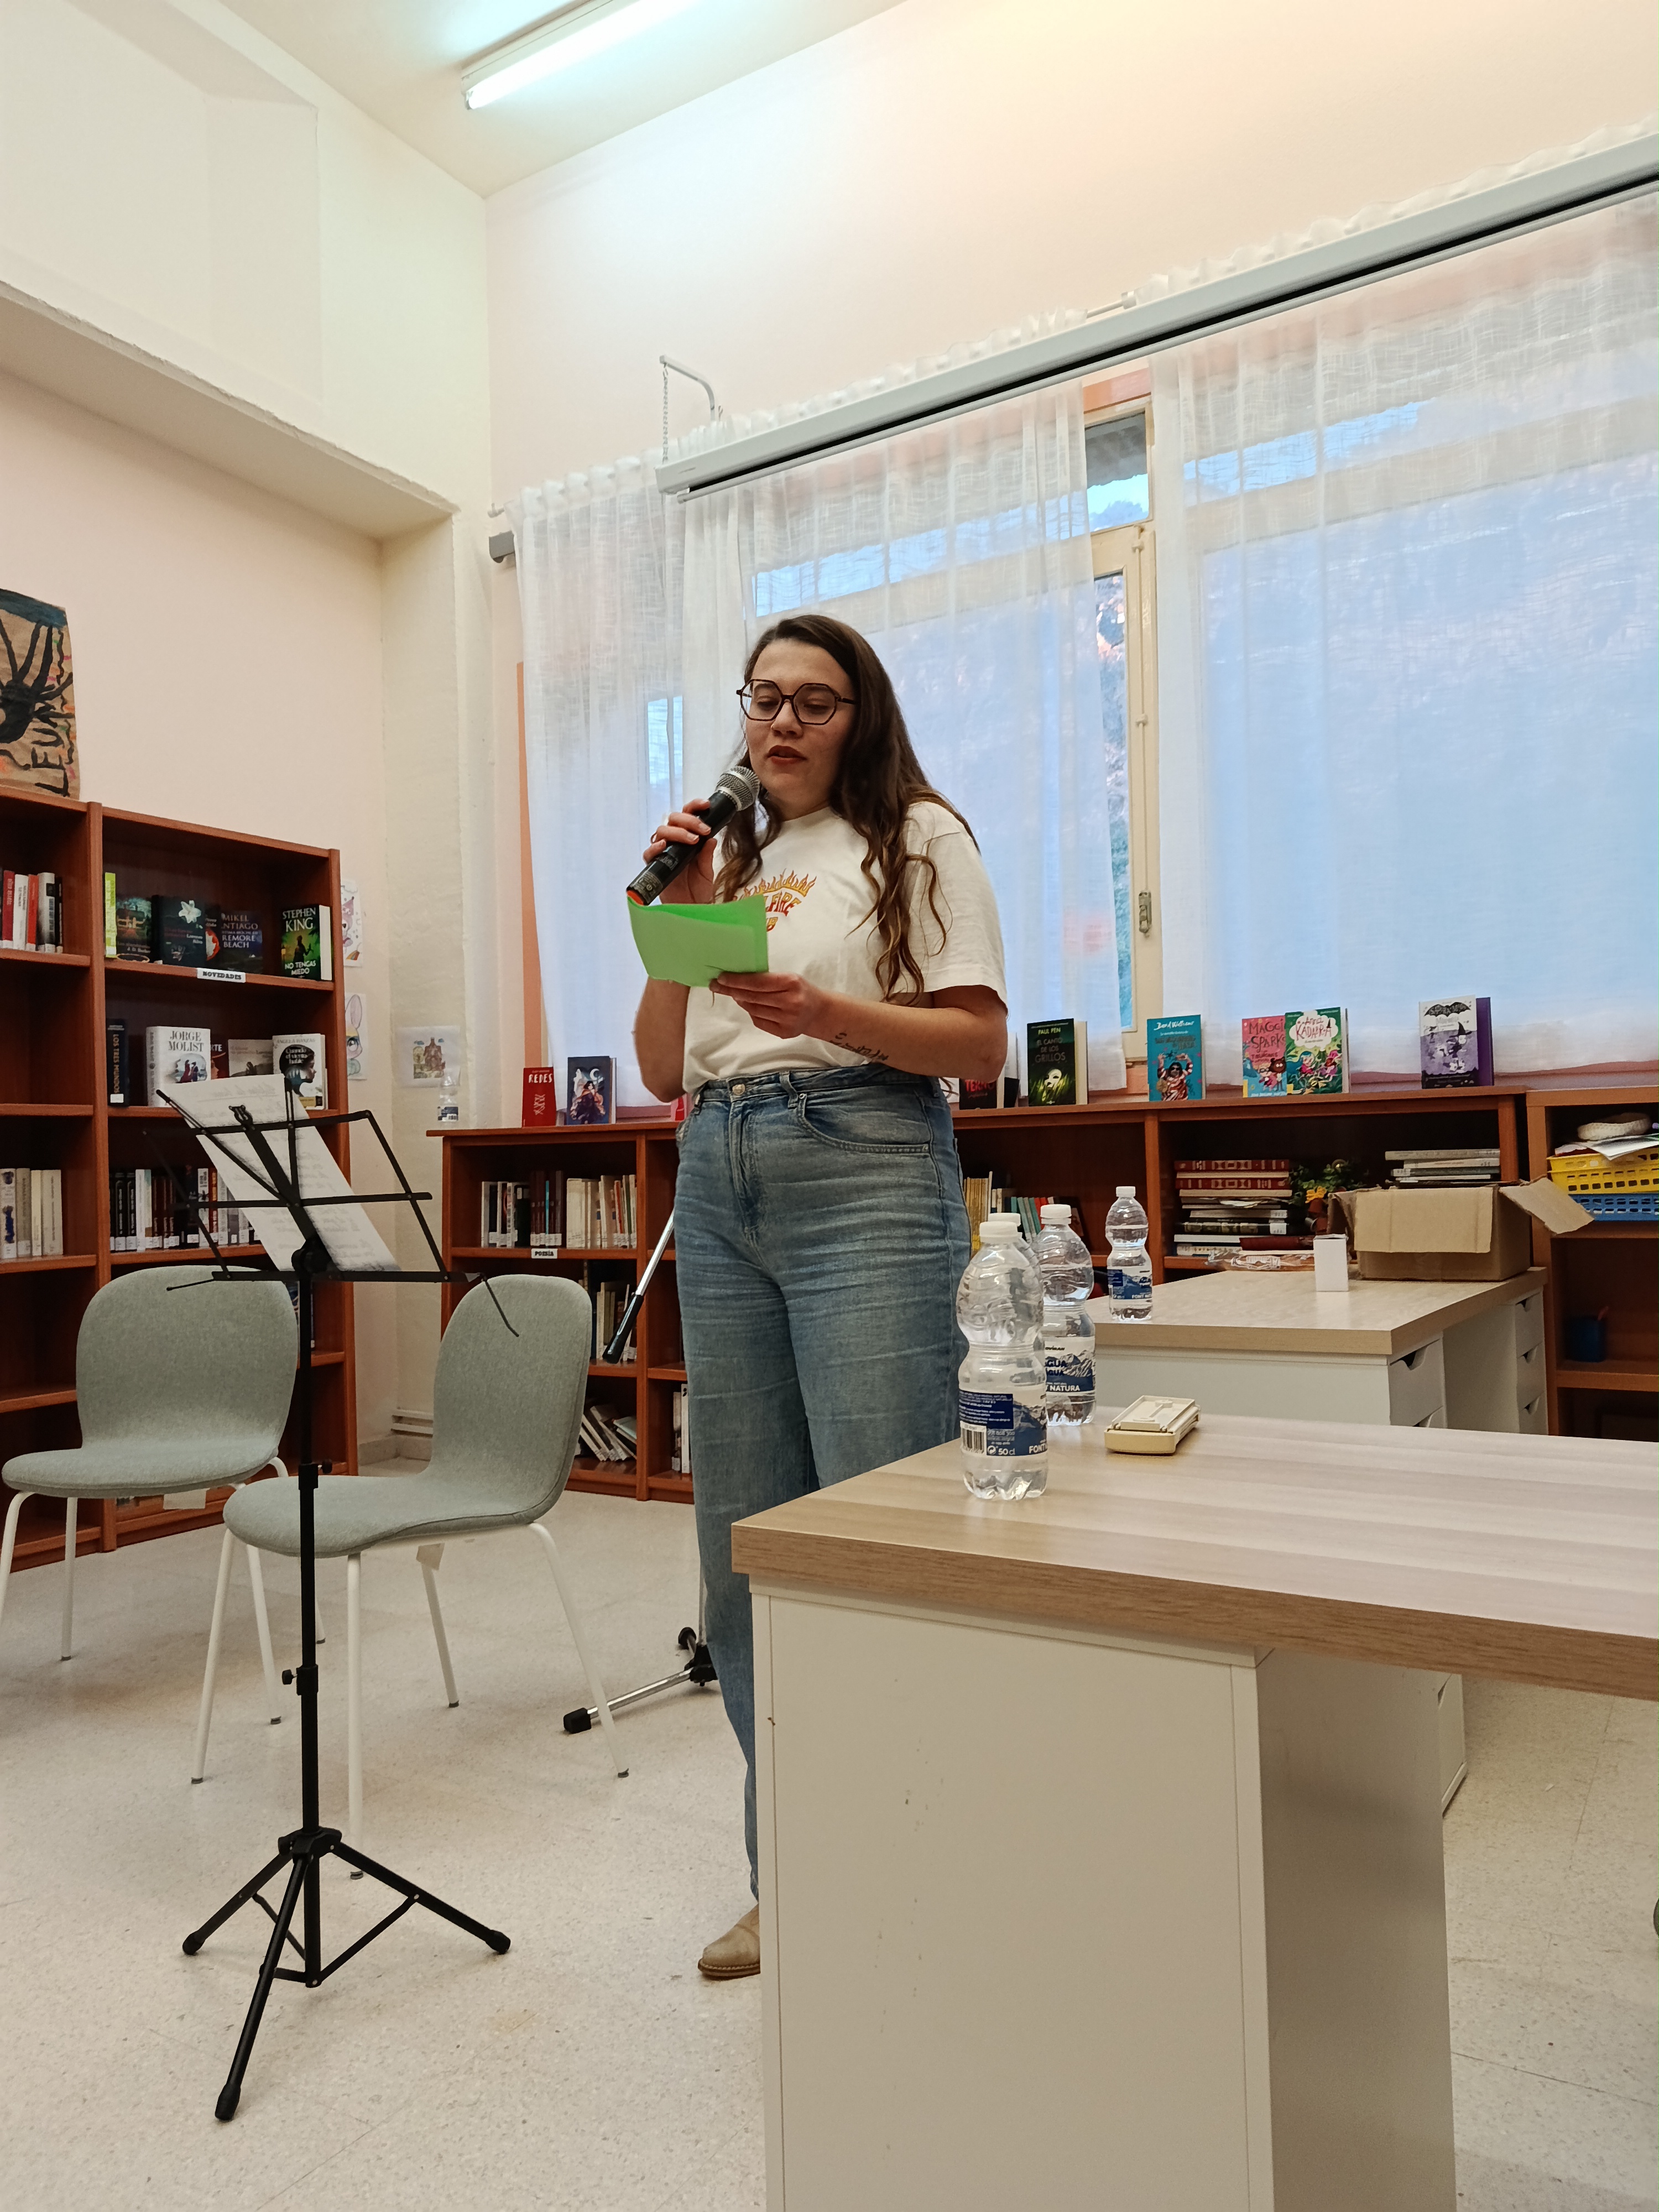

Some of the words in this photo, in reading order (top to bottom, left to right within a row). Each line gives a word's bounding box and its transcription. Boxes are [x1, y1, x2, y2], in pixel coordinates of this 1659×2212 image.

[283, 907, 316, 920] STEPHEN
[286, 917, 314, 932] KING
[295, 960, 316, 968] TENGAS
[202, 971, 242, 980] NOVEDADES
[1249, 1018, 1284, 1035] MAGGI
[170, 1031, 202, 1042] JORGE
[1044, 1037, 1063, 1045] CANTO
[169, 1041, 204, 1052] MOLIST
[1035, 1052, 1066, 1063] GRILLOS
[529, 1073, 553, 1083] REDES
[1029, 1443, 1045, 1454] FONT
